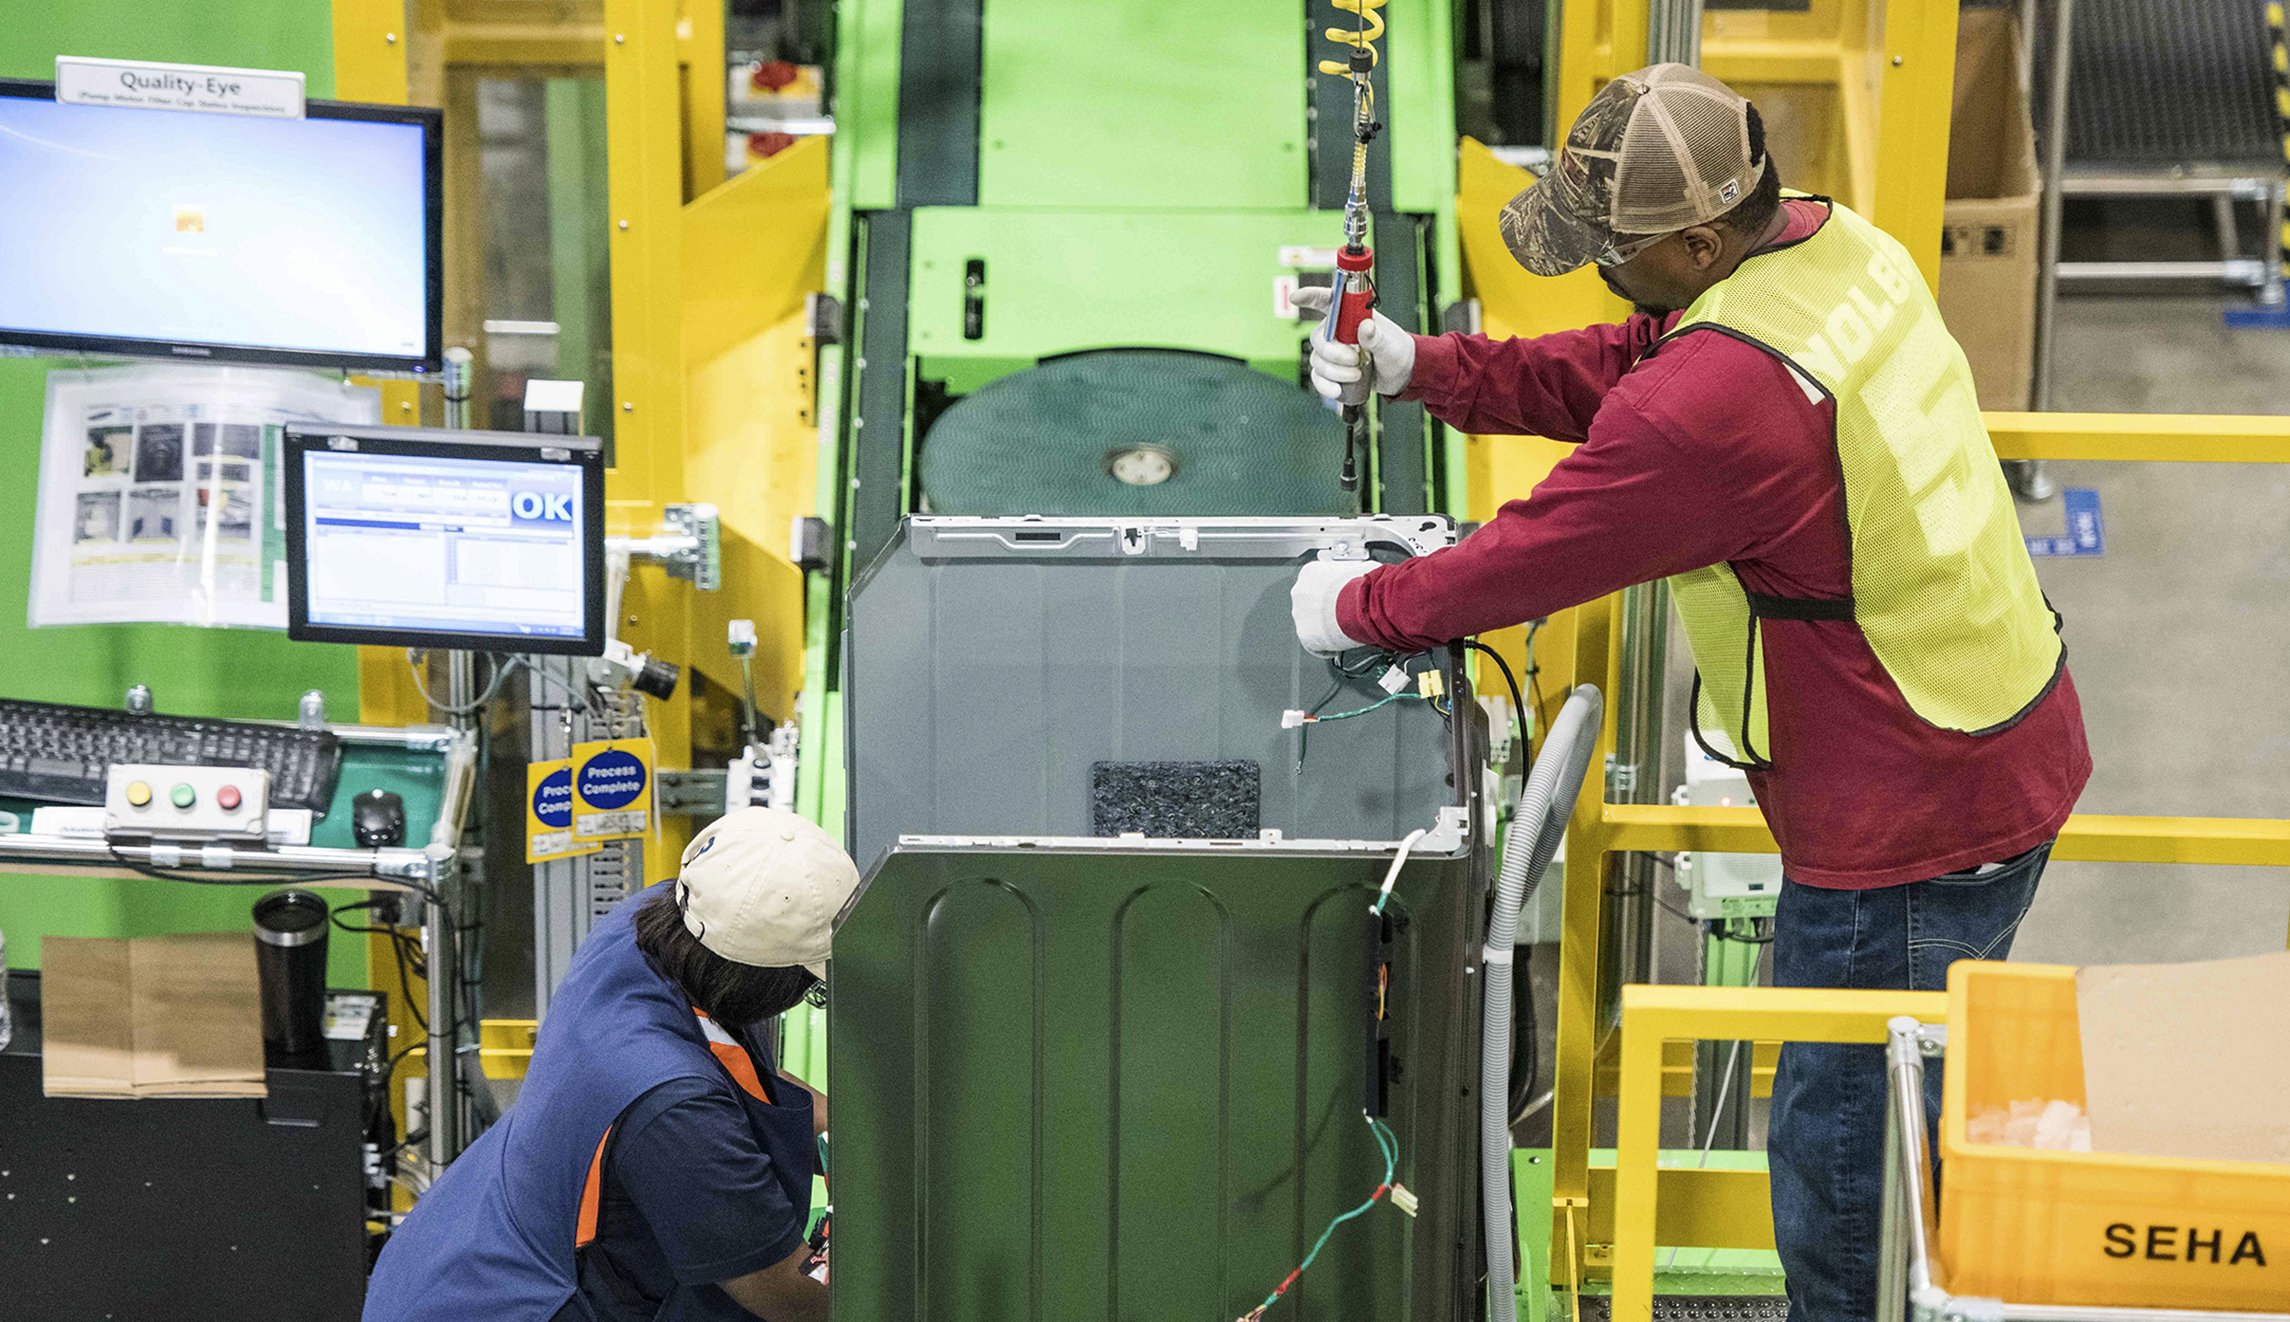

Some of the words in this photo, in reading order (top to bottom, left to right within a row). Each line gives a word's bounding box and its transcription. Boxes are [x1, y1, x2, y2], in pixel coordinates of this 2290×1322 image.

[120, 71, 241, 97] Quality-Eye
[512, 491, 572, 521] OK
[588, 766, 636, 779] Process
[583, 781, 640, 795] Complete
[2103, 1223, 2267, 1267] SEHA
